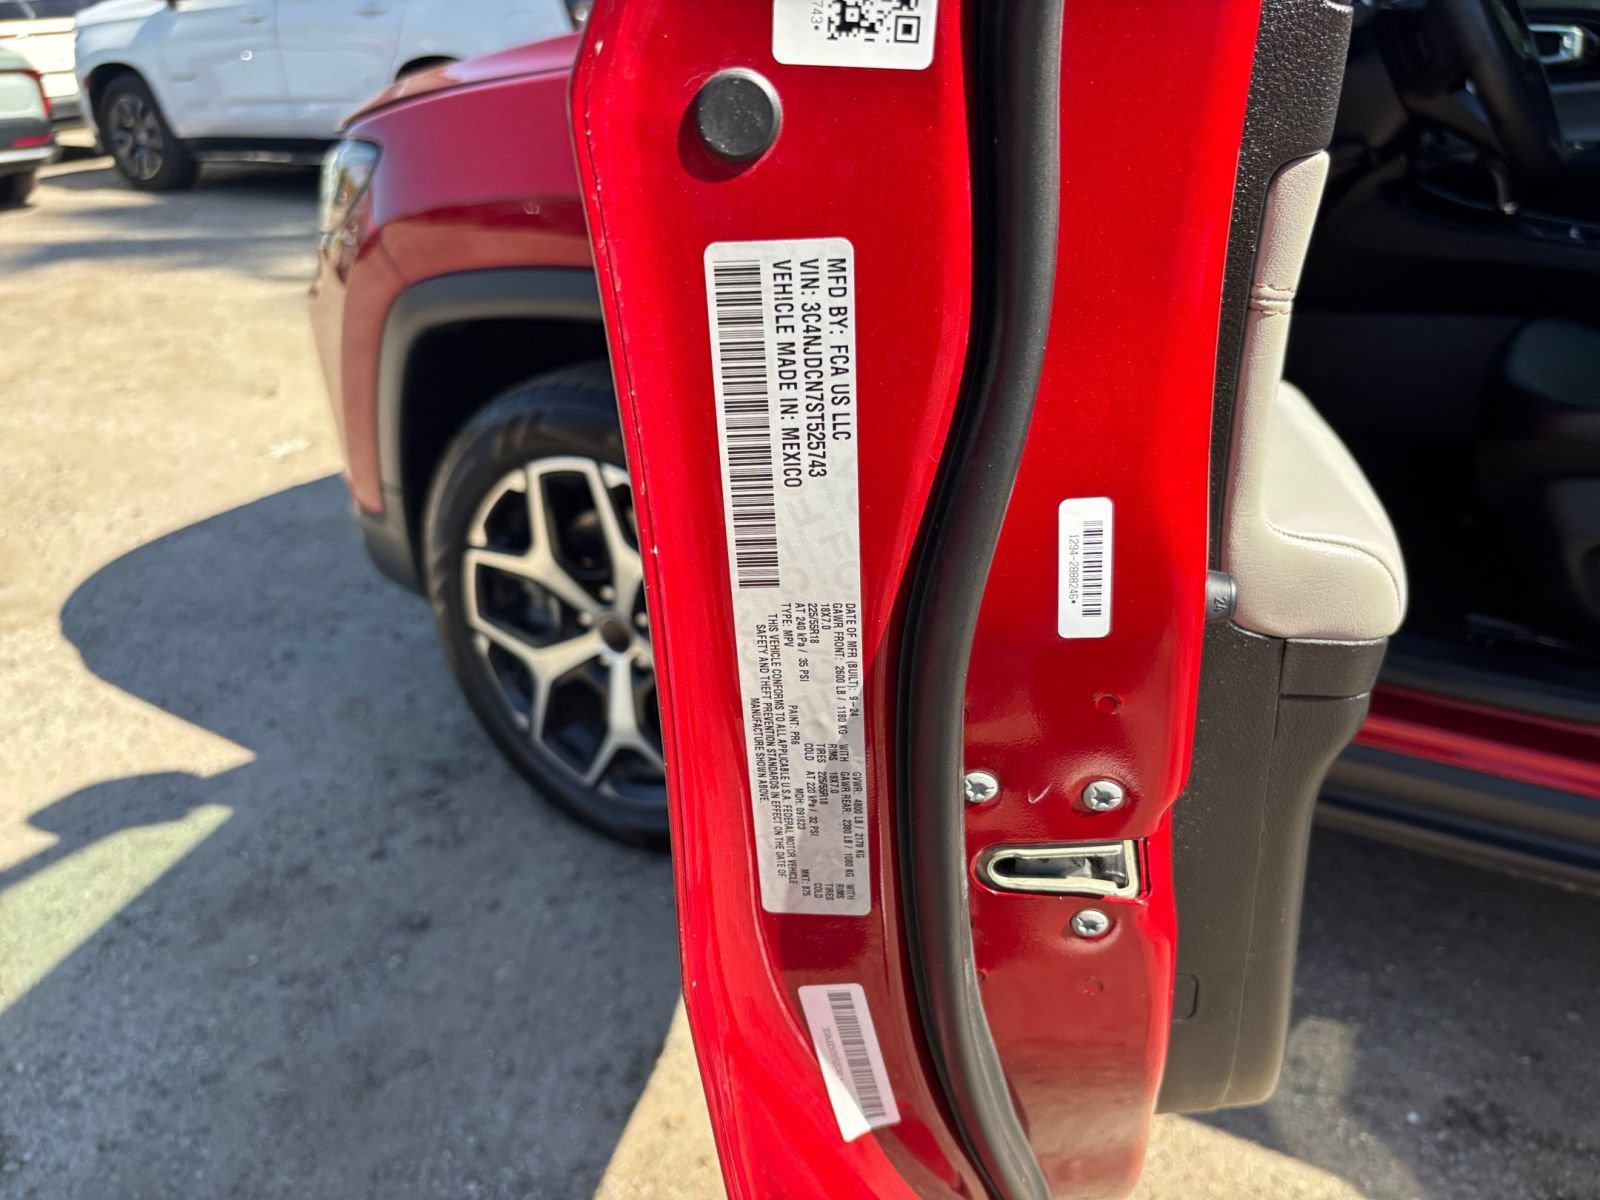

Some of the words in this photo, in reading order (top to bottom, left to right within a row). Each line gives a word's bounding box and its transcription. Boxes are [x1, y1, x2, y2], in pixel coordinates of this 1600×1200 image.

[800, 259, 820, 295] VIN:
[827, 258, 846, 298] MFD
[773, 260, 795, 334] VEHICLE
[829, 307, 847, 334] BY:
[777, 342, 798, 391] MADE
[830, 345, 849, 376] FCA
[802, 302, 827, 478] 3C4NJDCN7ST525743
[832, 384, 850, 406] US
[780, 398, 799, 420] IN:
[833, 413, 851, 440] LLC
[782, 427, 802, 488] MEXICO
[781, 603, 792, 626] TYPE:
[795, 603, 805, 613] AT
[833, 603, 844, 628] GAWR
[846, 603, 856, 625] DATE
[768, 614, 778, 631] THIS
[796, 617, 806, 630] 240
[756, 625, 769, 653] SAFETY
[783, 630, 793, 647] MPV
[797, 633, 807, 647] kPa
[847, 628, 856, 637] OF
[770, 635, 781, 666] VEHICLE
[834, 632, 844, 660] FRONT:
[847, 641, 857, 657] MFR
[759, 657, 770, 673] AND
[799, 658, 807, 667] 35
[800, 670, 809, 682] PSI
[808, 603, 819, 643] 225/55R18
[816, 744, 826, 763] TIRES
[821, 604, 830, 630] 18X7.0
[828, 744, 837, 761] RIMS
[835, 666, 845, 683] 2600
[847, 661, 858, 690] (BUILT):
[761, 676, 772, 699] THEFT
[772, 669, 784, 710] CONFORMS
[836, 686, 846, 694] LB
[837, 706, 847, 722] 1180
[849, 697, 858, 716] 9-24
[751, 698, 764, 750] MANUFACTURE
[763, 703, 775, 746] PREVENTION
[776, 713, 785, 721] TO
[788, 705, 799, 728] PAINT:
[777, 724, 786, 736] ALL
[790, 731, 800, 744] PR6
[839, 725, 847, 734] KG
[777, 739, 790, 780] APPLICABLE
[804, 743, 814, 761] COLD
[839, 744, 849, 762] WITH
[755, 753, 767, 778] SHOWN
[767, 749, 781, 789] STANDARDS
[806, 771, 815, 780] AT
[841, 772, 849, 792] GAWR
[853, 772, 862, 794] GVWR:
[781, 783, 792, 802] U.S.A.
[794, 788, 803, 805] MDH:
[806, 782, 816, 793] 220
[807, 795, 817, 807] kPa
[842, 794, 850, 814] REAR:
[854, 799, 863, 814] 4800
[772, 800, 783, 824] EFFECT
[784, 805, 793, 833] FEDERAL
[809, 816, 818, 824] 32
[854, 816, 864, 824] LB
[774, 826, 783, 835] ON
[810, 826, 818, 836] PSI
[818, 771, 828, 805] 225/55R18
[825, 883, 834, 900] TIRES
[829, 772, 838, 793] 18X7.0
[836, 884, 844, 898] RIMS
[775, 838, 784, 849] THE
[786, 836, 795, 857] MOTOR
[776, 851, 785, 867] DATE
[856, 850, 865, 858] KG
[778, 869, 786, 877] OF
[788, 860, 797, 884] VEHICLE
[801, 869, 809, 884] MKT:
[846, 869, 854, 877] KG
[814, 883, 822, 898] COLD
[847, 884, 855, 900] WITH
